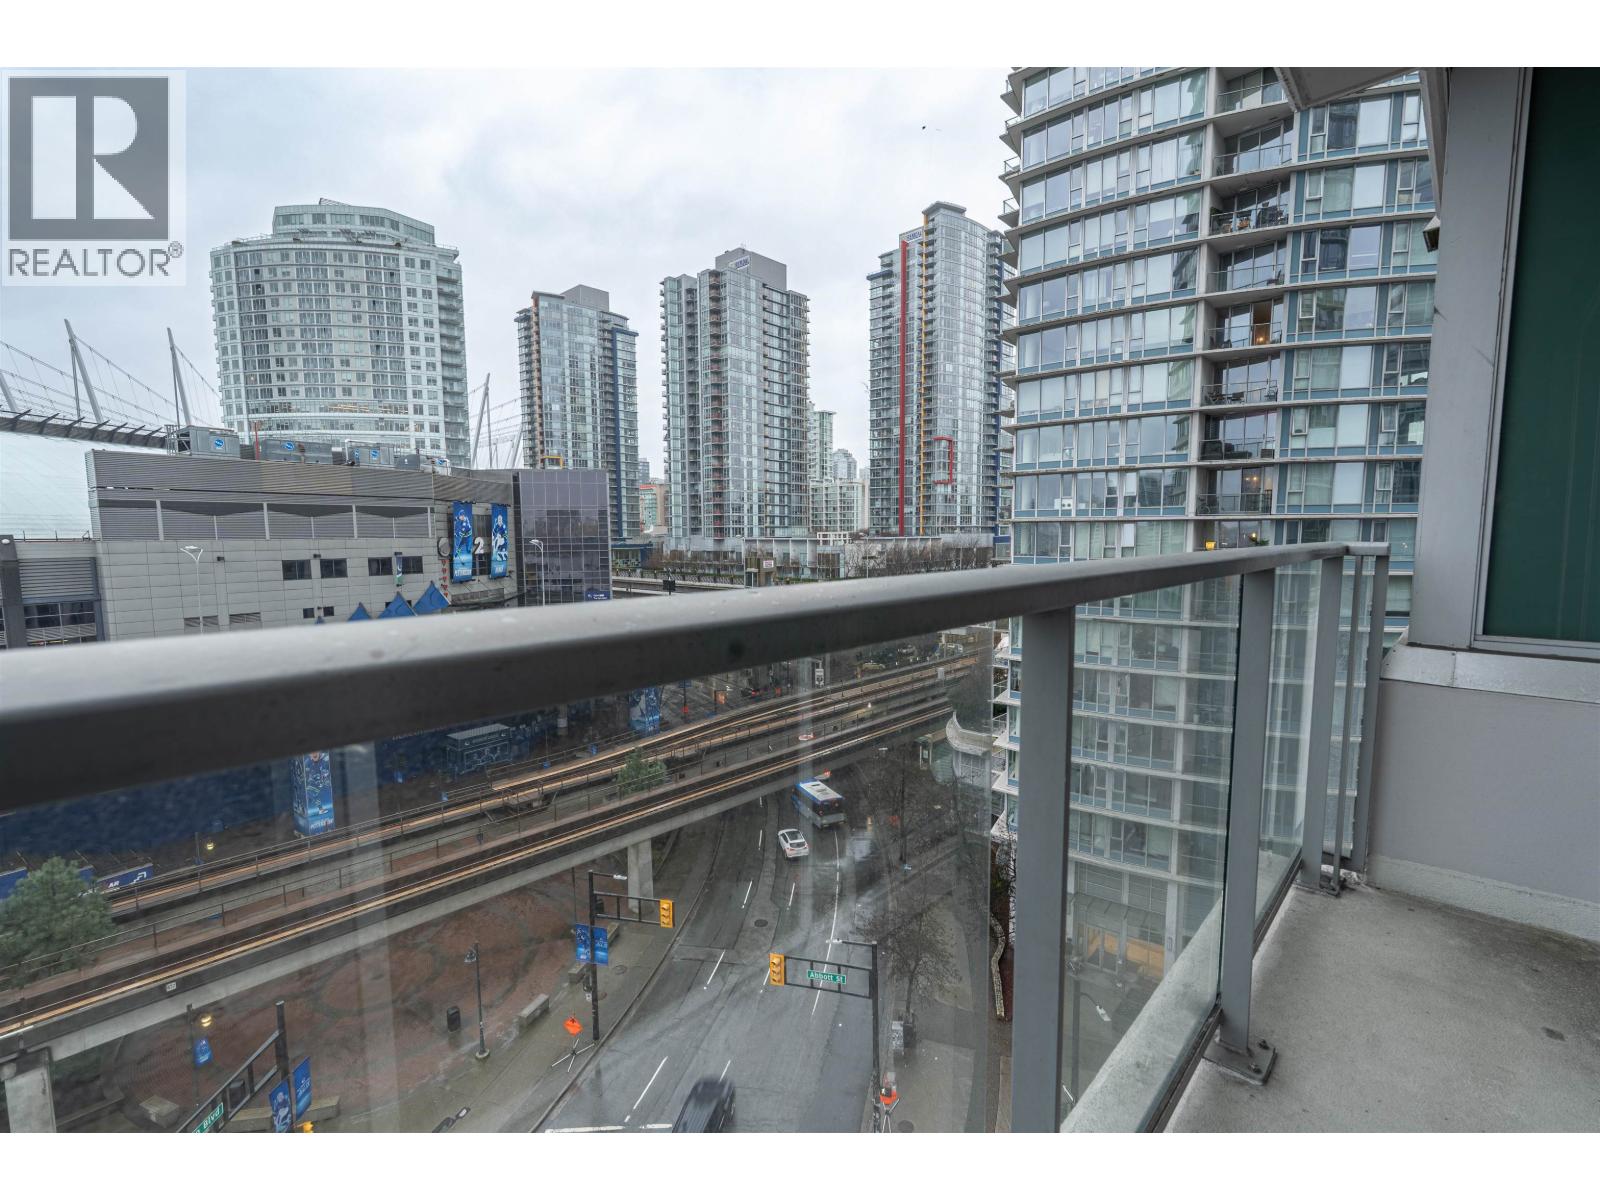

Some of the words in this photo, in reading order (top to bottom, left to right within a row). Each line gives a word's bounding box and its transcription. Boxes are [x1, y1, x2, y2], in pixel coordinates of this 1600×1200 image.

[810, 972, 834, 981] Abbott
[836, 975, 843, 983] St
[204, 1107, 220, 1129] Blvd
